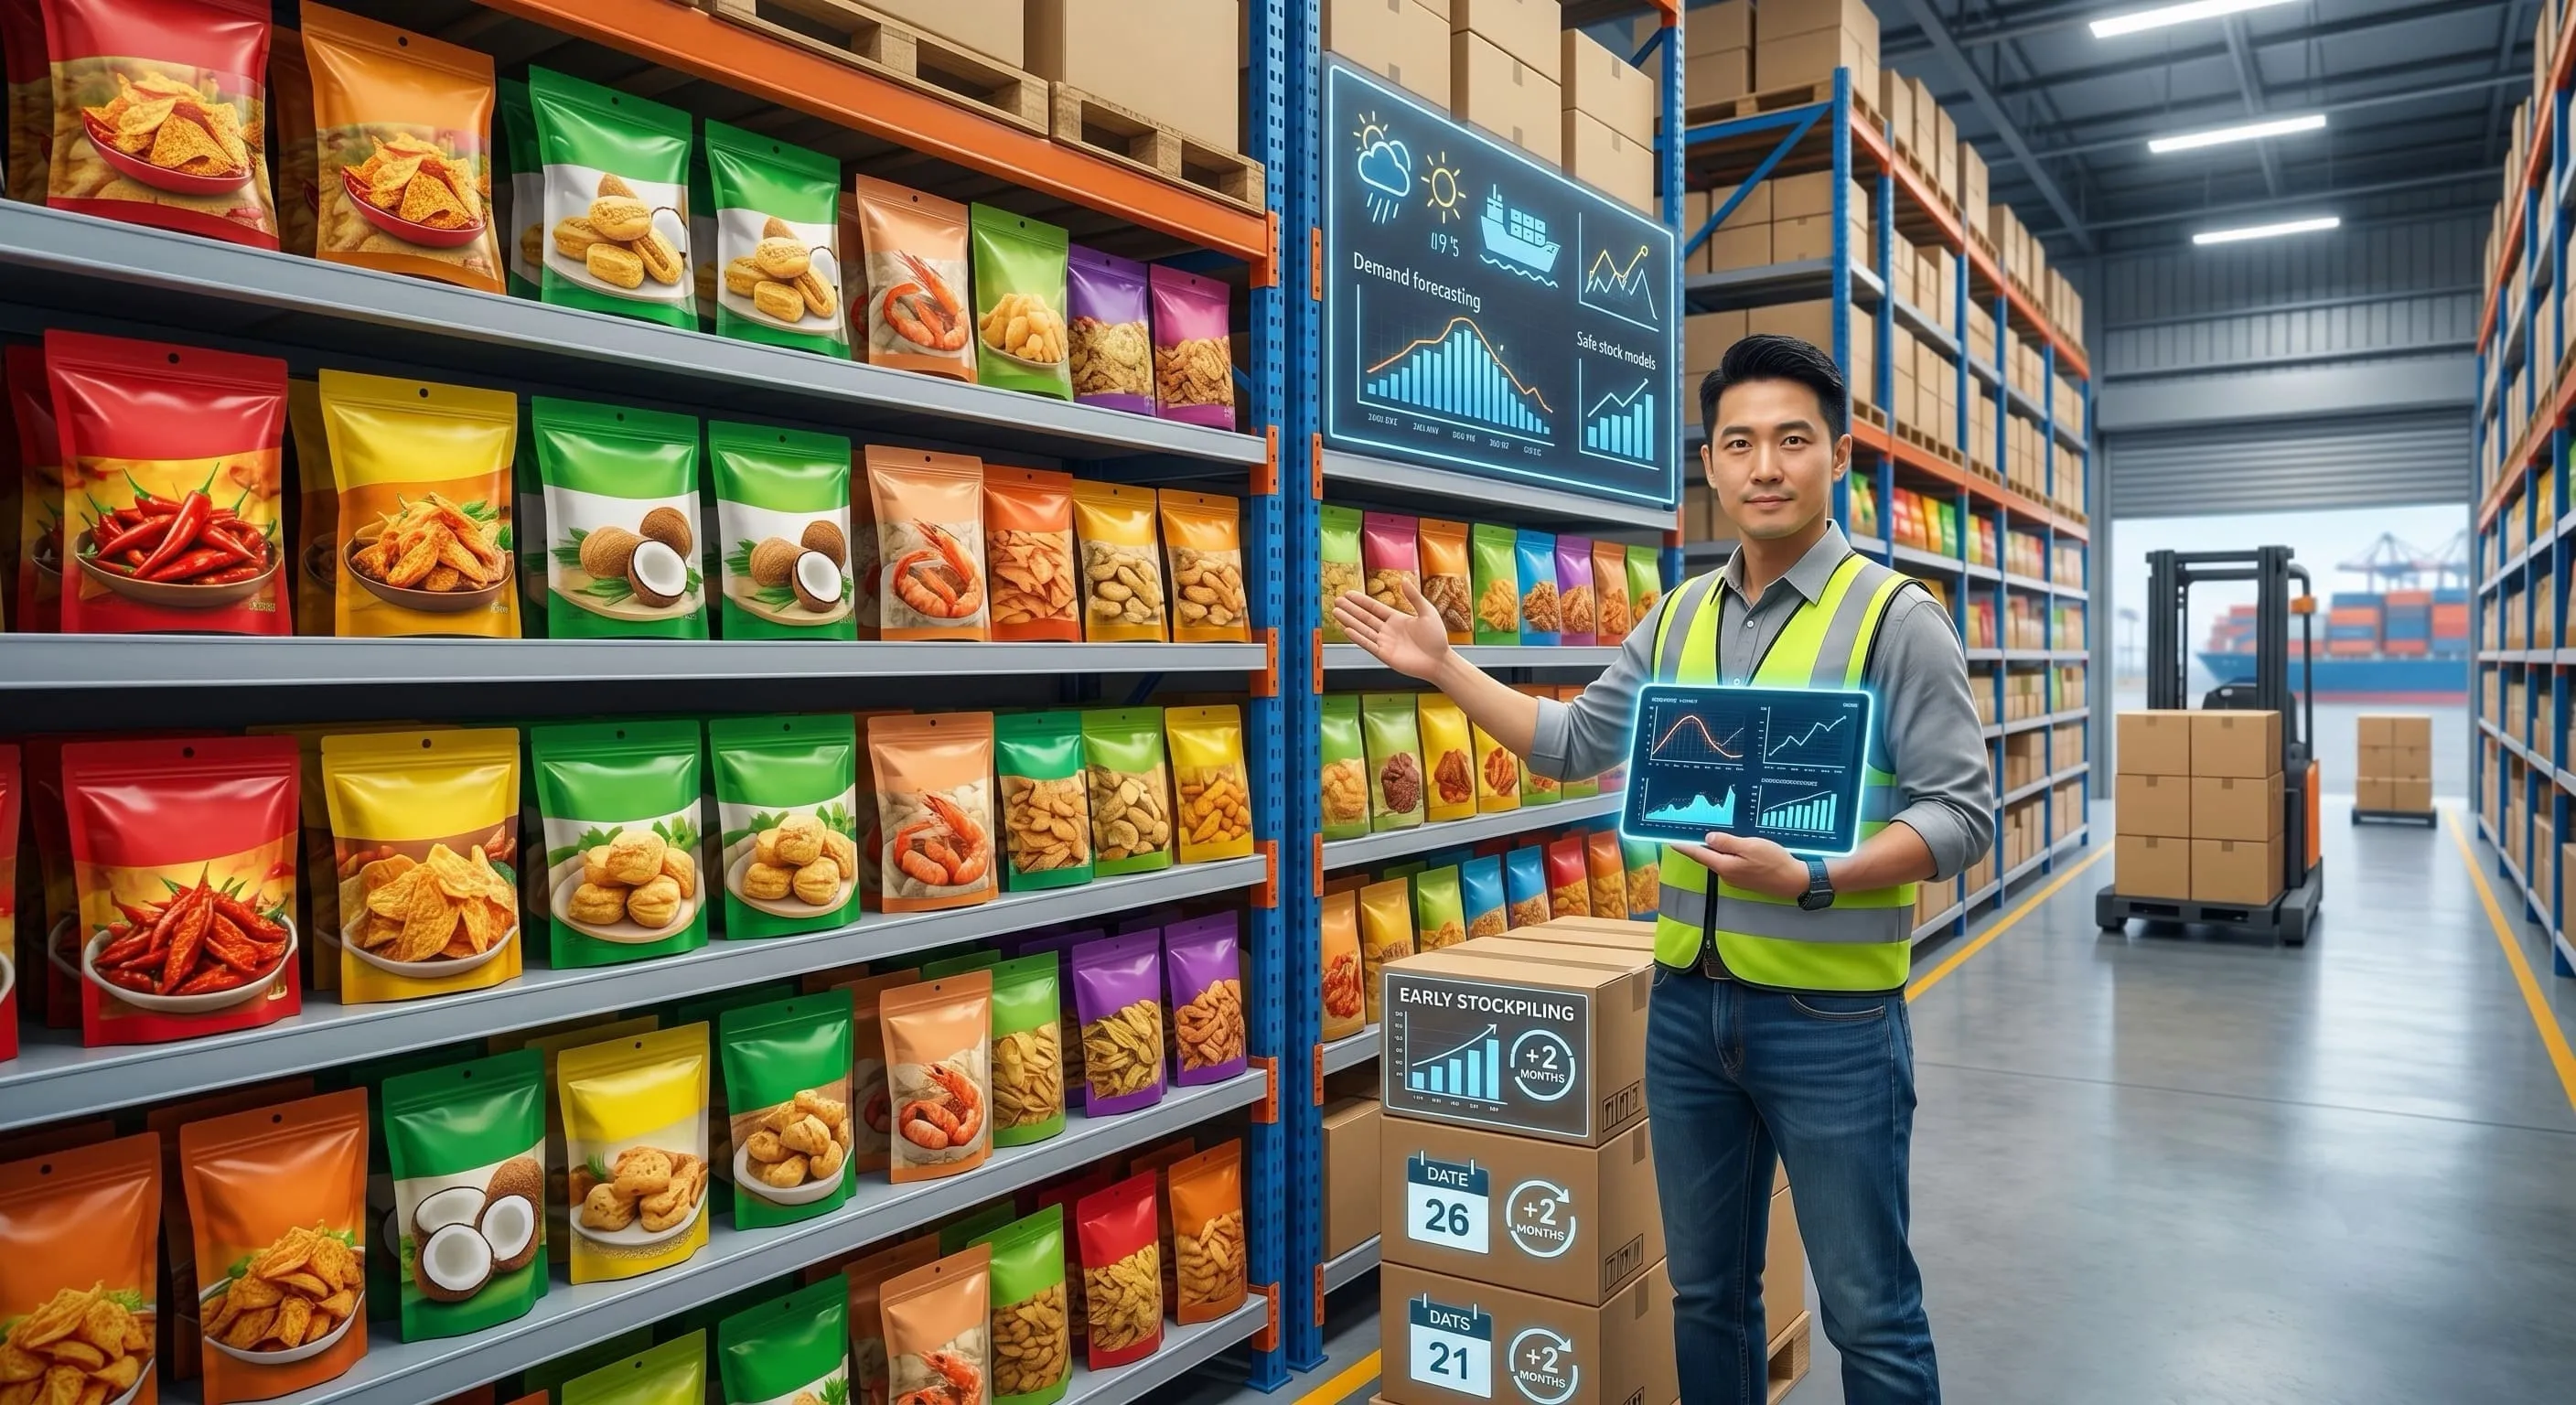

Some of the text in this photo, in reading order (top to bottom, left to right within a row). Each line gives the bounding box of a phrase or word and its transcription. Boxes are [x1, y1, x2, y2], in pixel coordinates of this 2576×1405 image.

[1354, 252, 1481, 313] Demand forecasting
[1576, 330, 1656, 370] Safe stock models
[1400, 987, 1574, 1022] EARLY STOCKPILING
[1520, 1068, 1565, 1084] MONTHS
[1427, 1166, 1469, 1187] DATE
[1425, 1198, 1469, 1237] 26
[1523, 1198, 1556, 1226] +2
[1516, 1224, 1565, 1241] MONTHS
[1430, 1309, 1471, 1331] DATS
[1429, 1341, 1467, 1380] 21
[1526, 1346, 1558, 1374] +2
[1519, 1369, 1566, 1389] MONTHS
